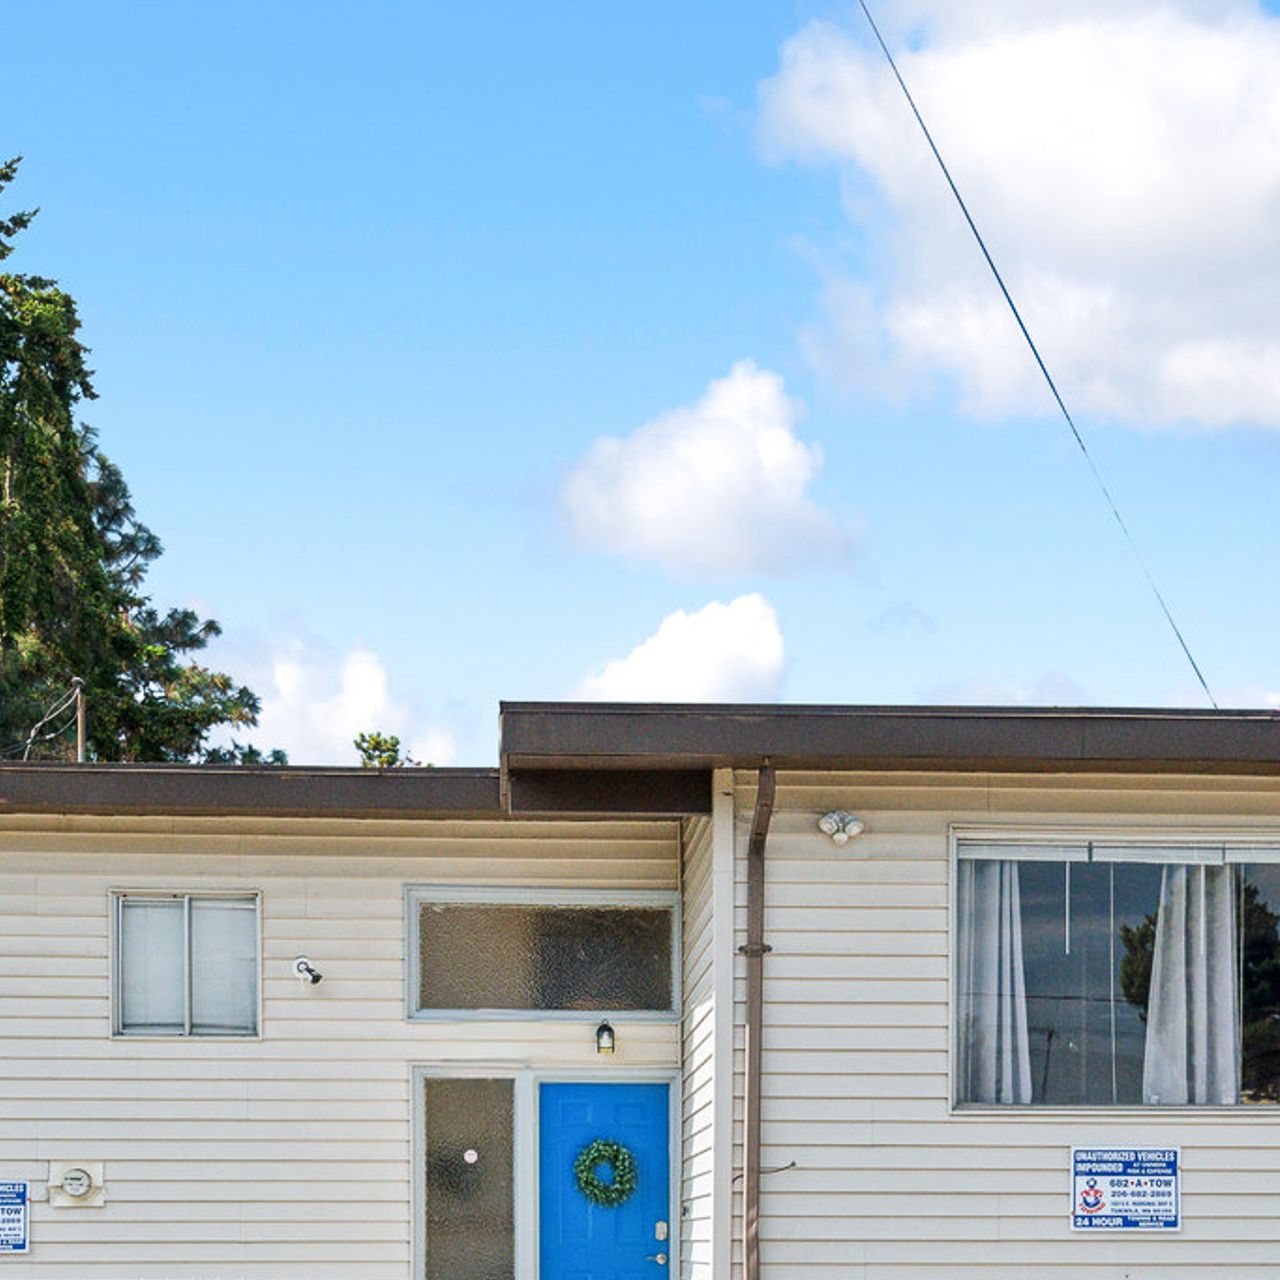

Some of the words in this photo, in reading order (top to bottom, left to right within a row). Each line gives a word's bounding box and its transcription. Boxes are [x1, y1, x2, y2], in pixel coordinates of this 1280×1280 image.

[1075, 1151, 1135, 1161] UNAUTHORIZED
[1137, 1151, 1175, 1161] VEHICLES
[1075, 1162, 1123, 1172] IMPOUNDED
[1075, 1216, 1089, 1226] 24
[1092, 1216, 1123, 1226] HOUR
